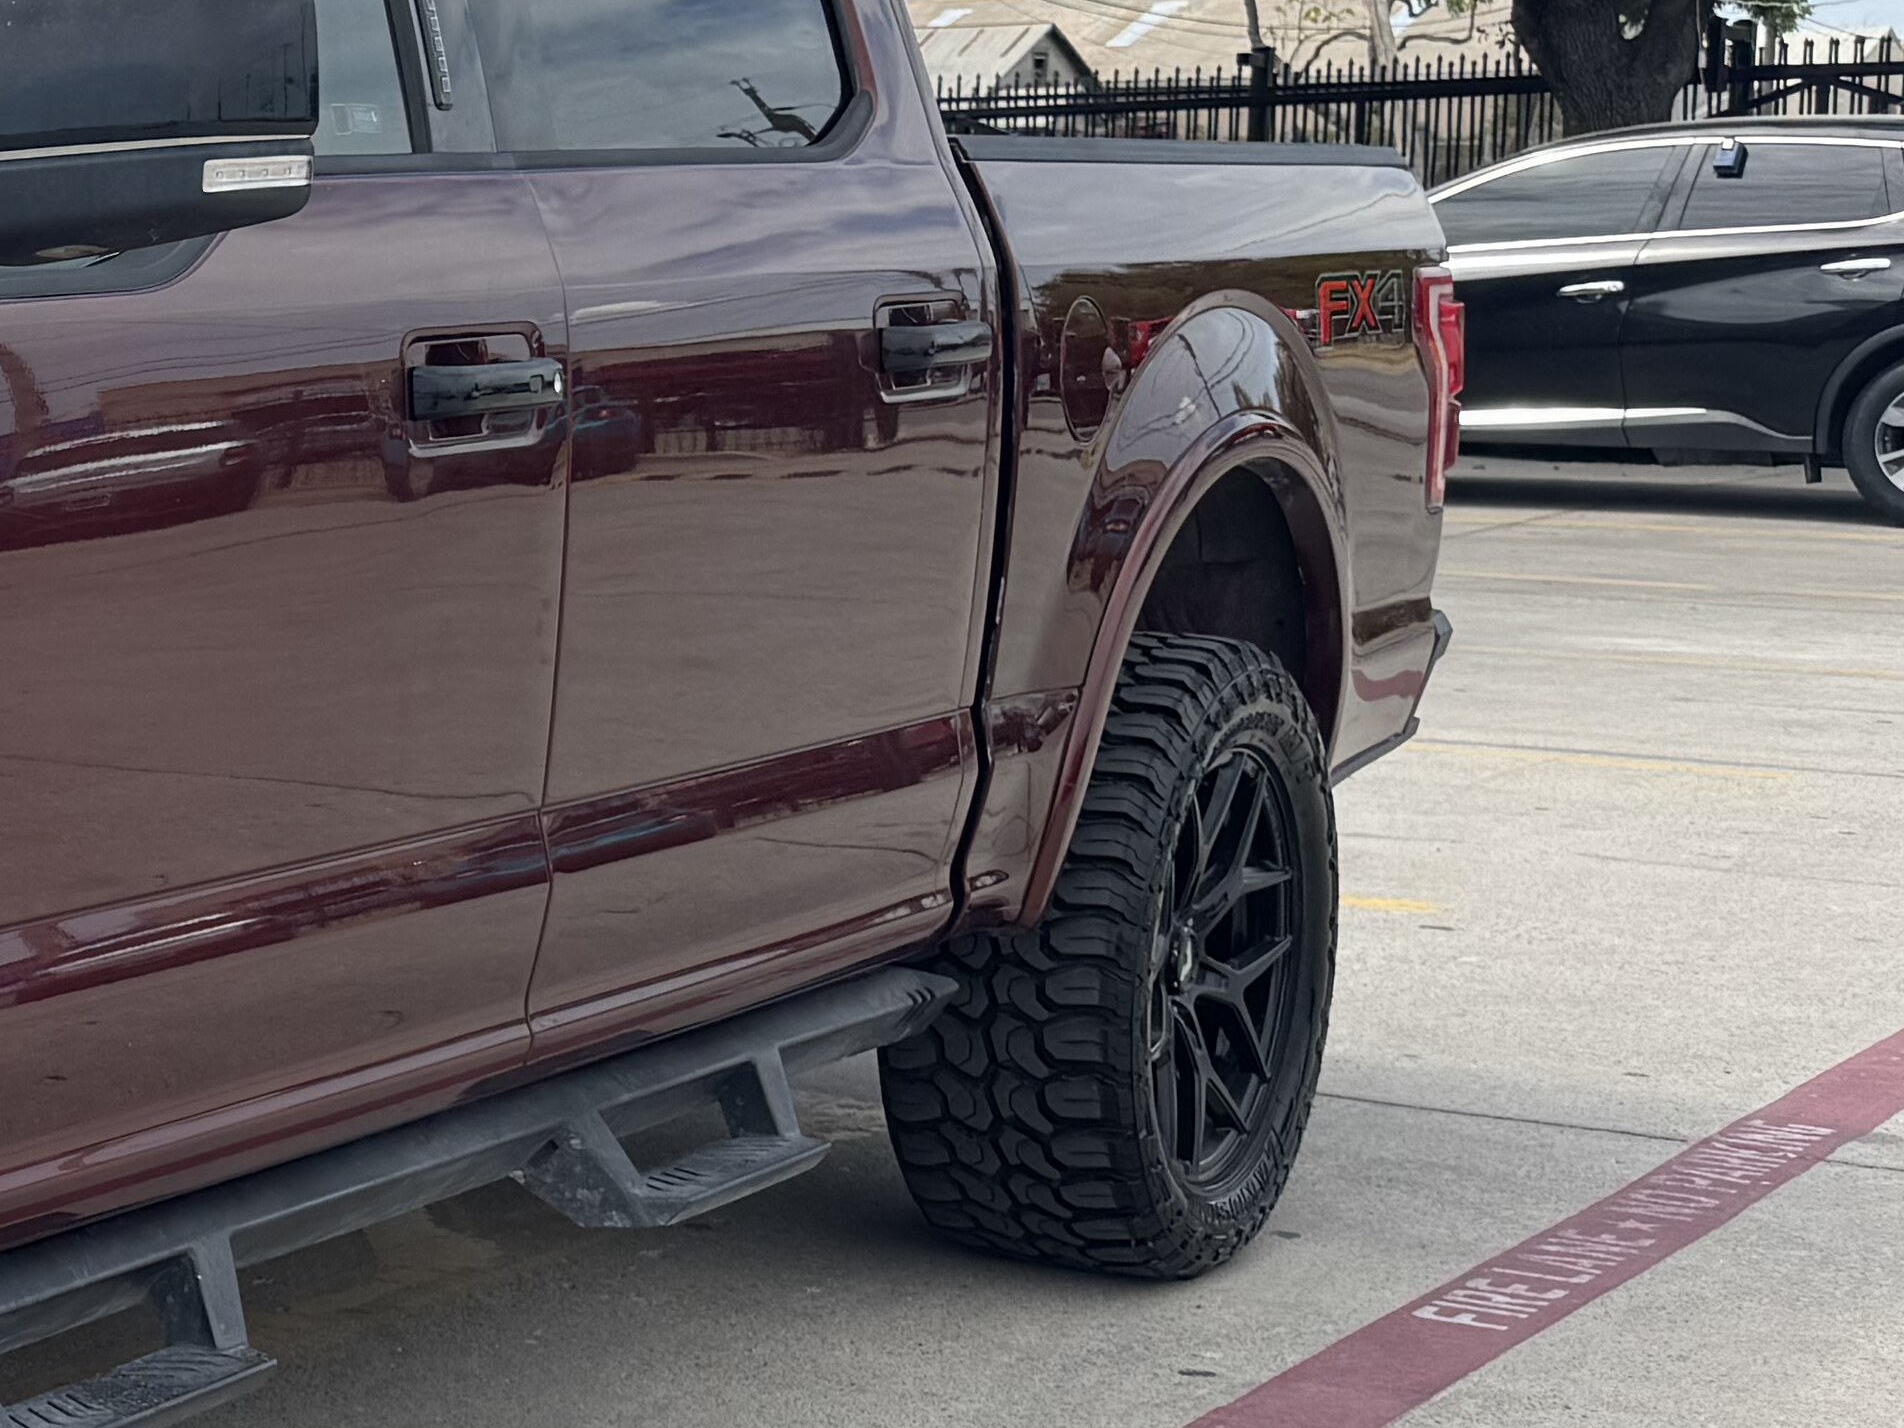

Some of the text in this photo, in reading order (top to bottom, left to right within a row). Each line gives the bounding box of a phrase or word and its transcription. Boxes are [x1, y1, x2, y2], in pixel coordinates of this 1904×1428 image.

[1315, 269, 1406, 352] FX4
[1411, 1119, 1837, 1331] FIRE LANE NO PARKING
